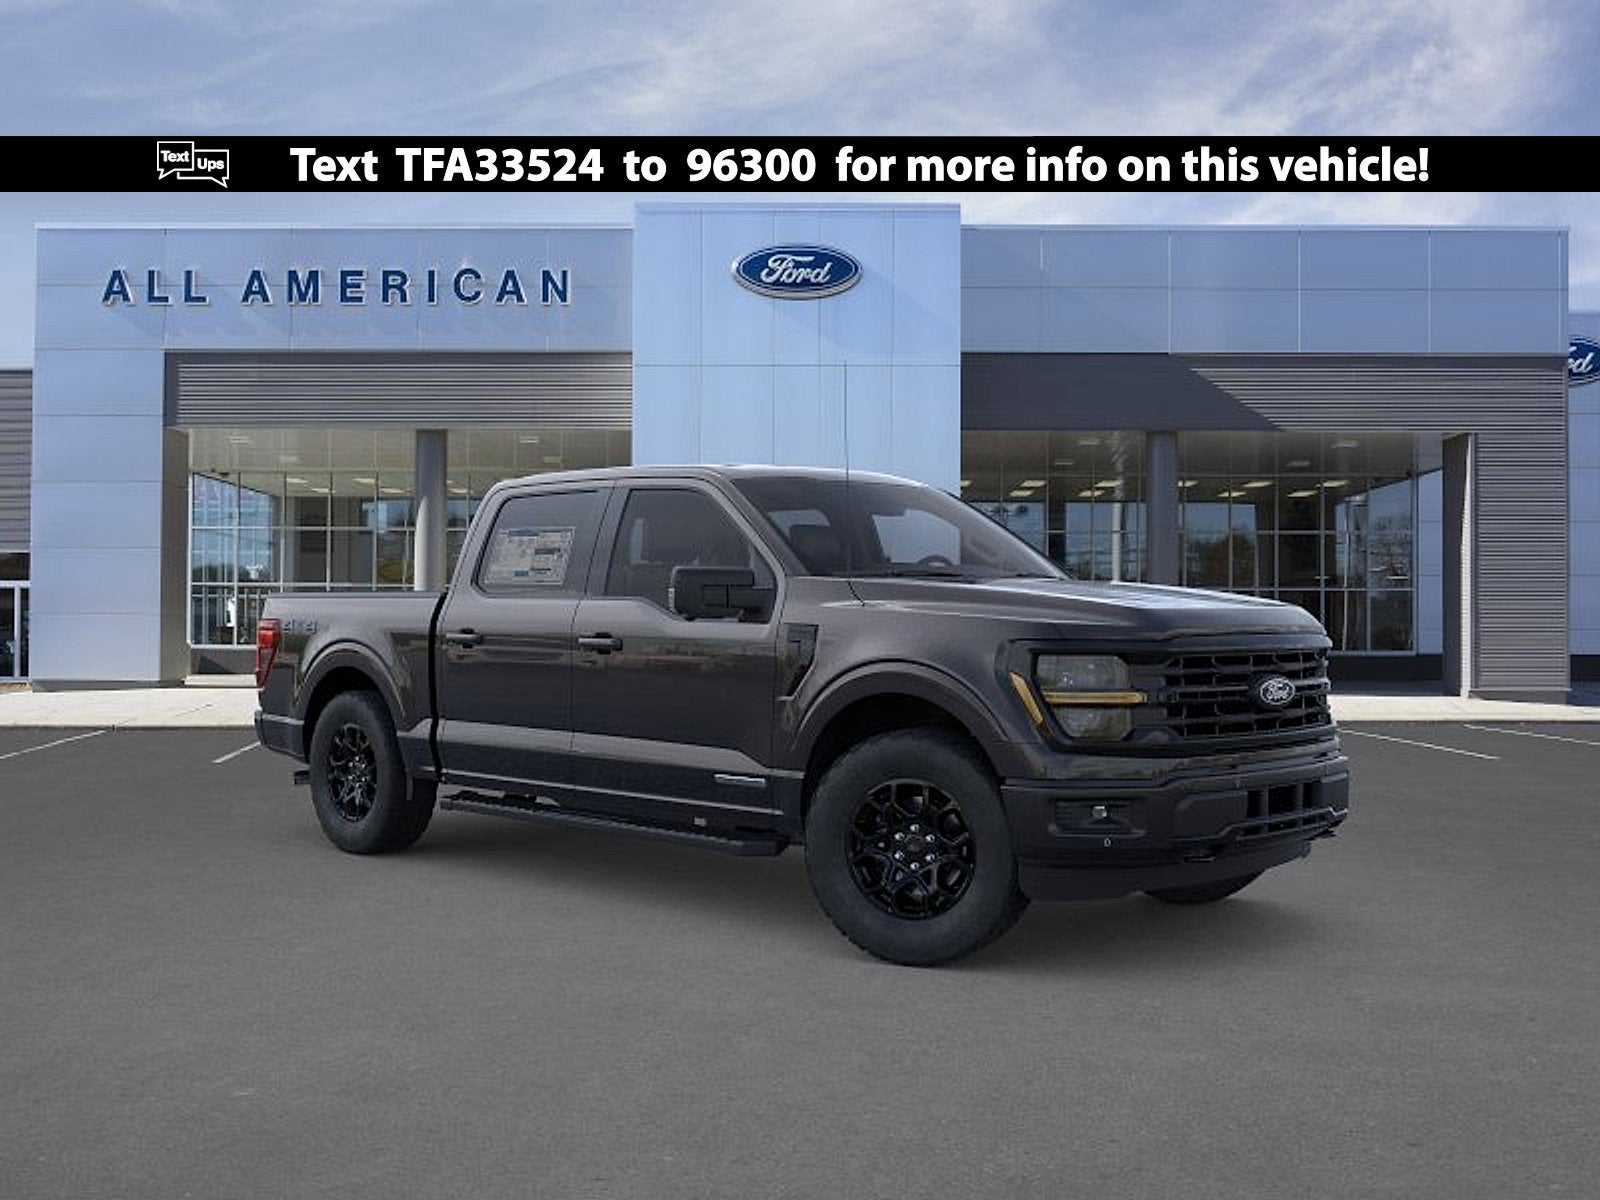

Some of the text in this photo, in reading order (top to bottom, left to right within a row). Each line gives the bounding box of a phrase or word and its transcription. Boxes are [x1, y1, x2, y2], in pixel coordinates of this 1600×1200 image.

[760, 253, 834, 284] Ford
[102, 268, 571, 306] ALL AMERICAN
